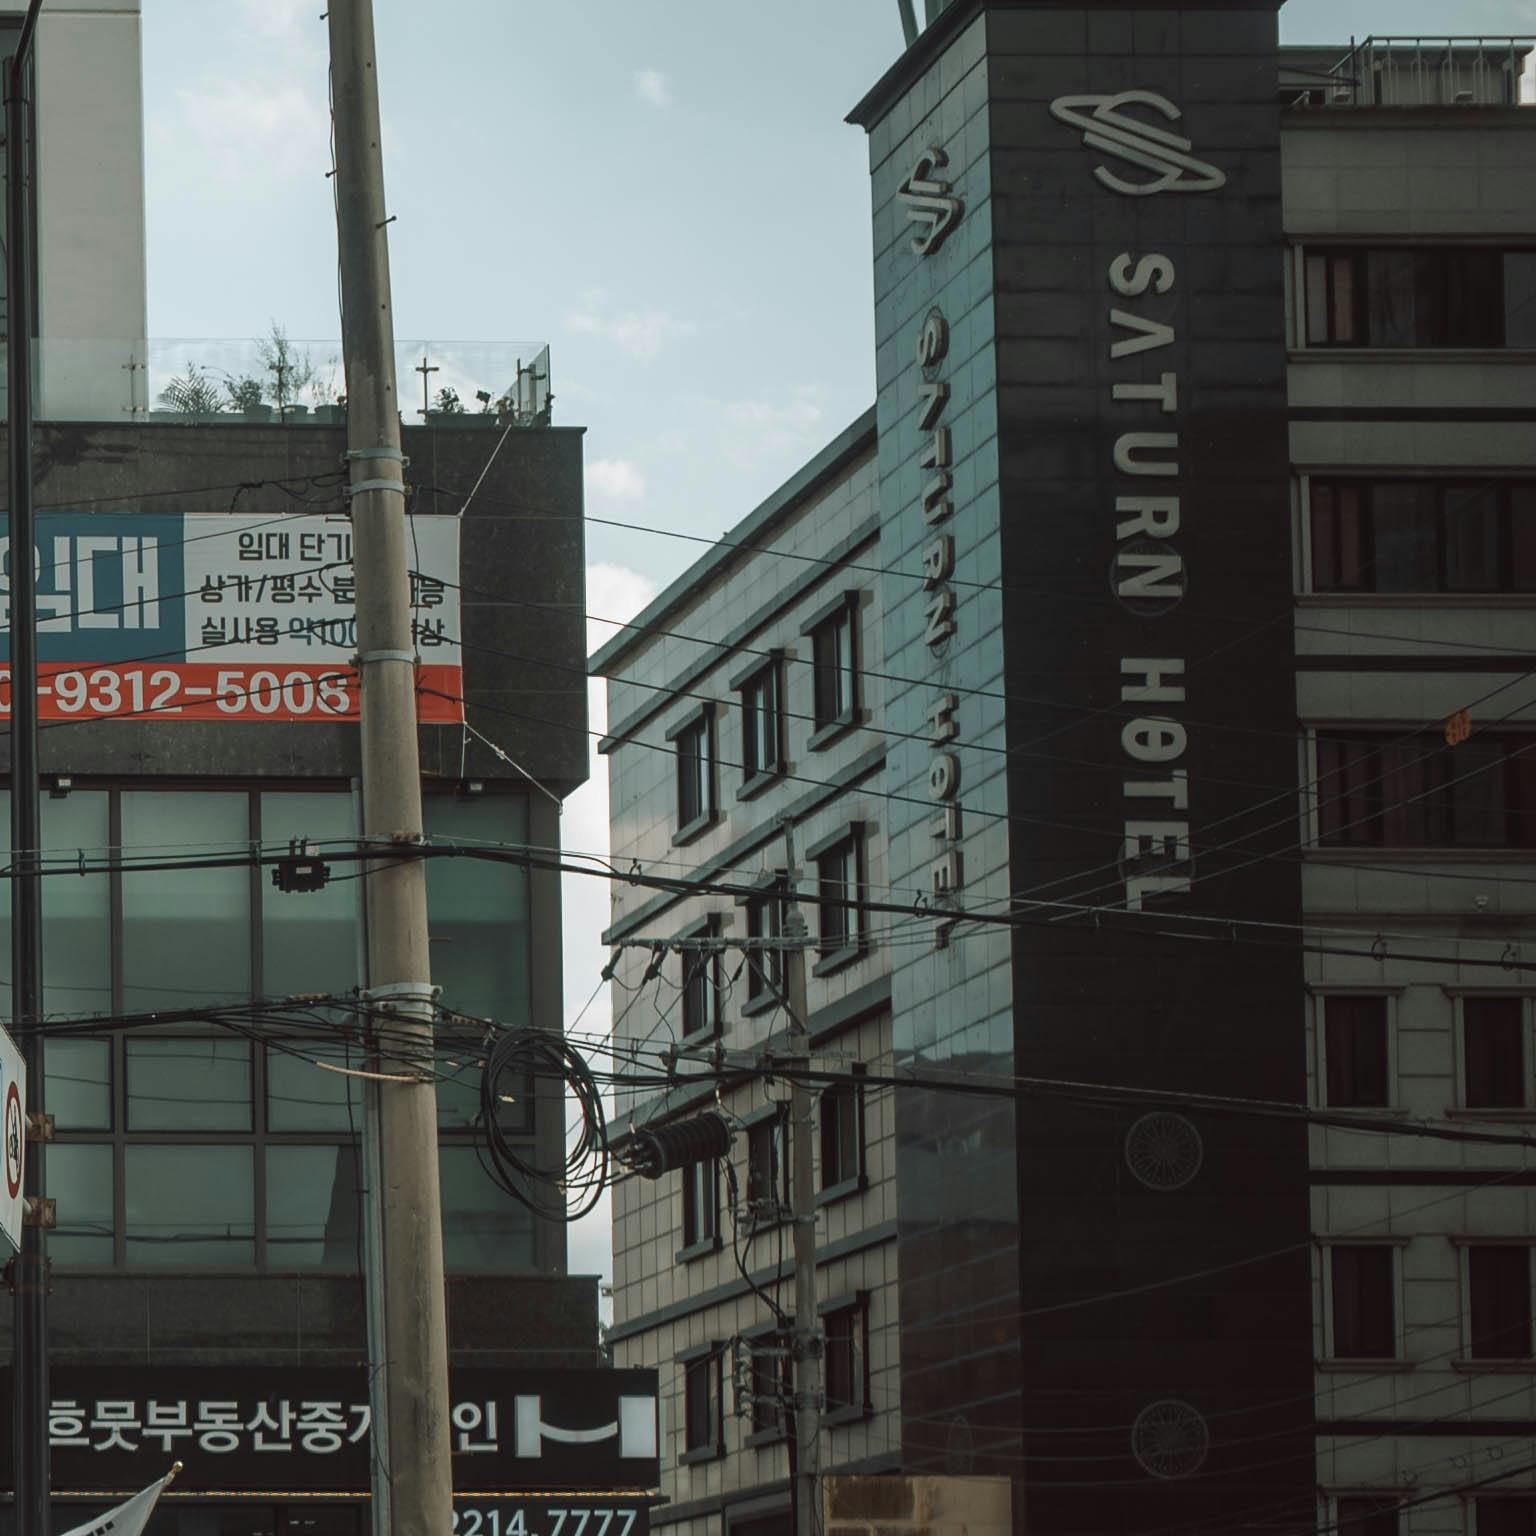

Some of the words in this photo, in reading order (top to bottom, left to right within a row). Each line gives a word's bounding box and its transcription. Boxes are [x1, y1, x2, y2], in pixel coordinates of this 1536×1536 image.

[1109, 252, 1184, 598] SATURN
[238, 532, 290, 561] 임대
[201, 574, 323, 604] 상가/평수
[201, 616, 279, 646] 실사용
[1121, 658, 1191, 911] HOTEL
